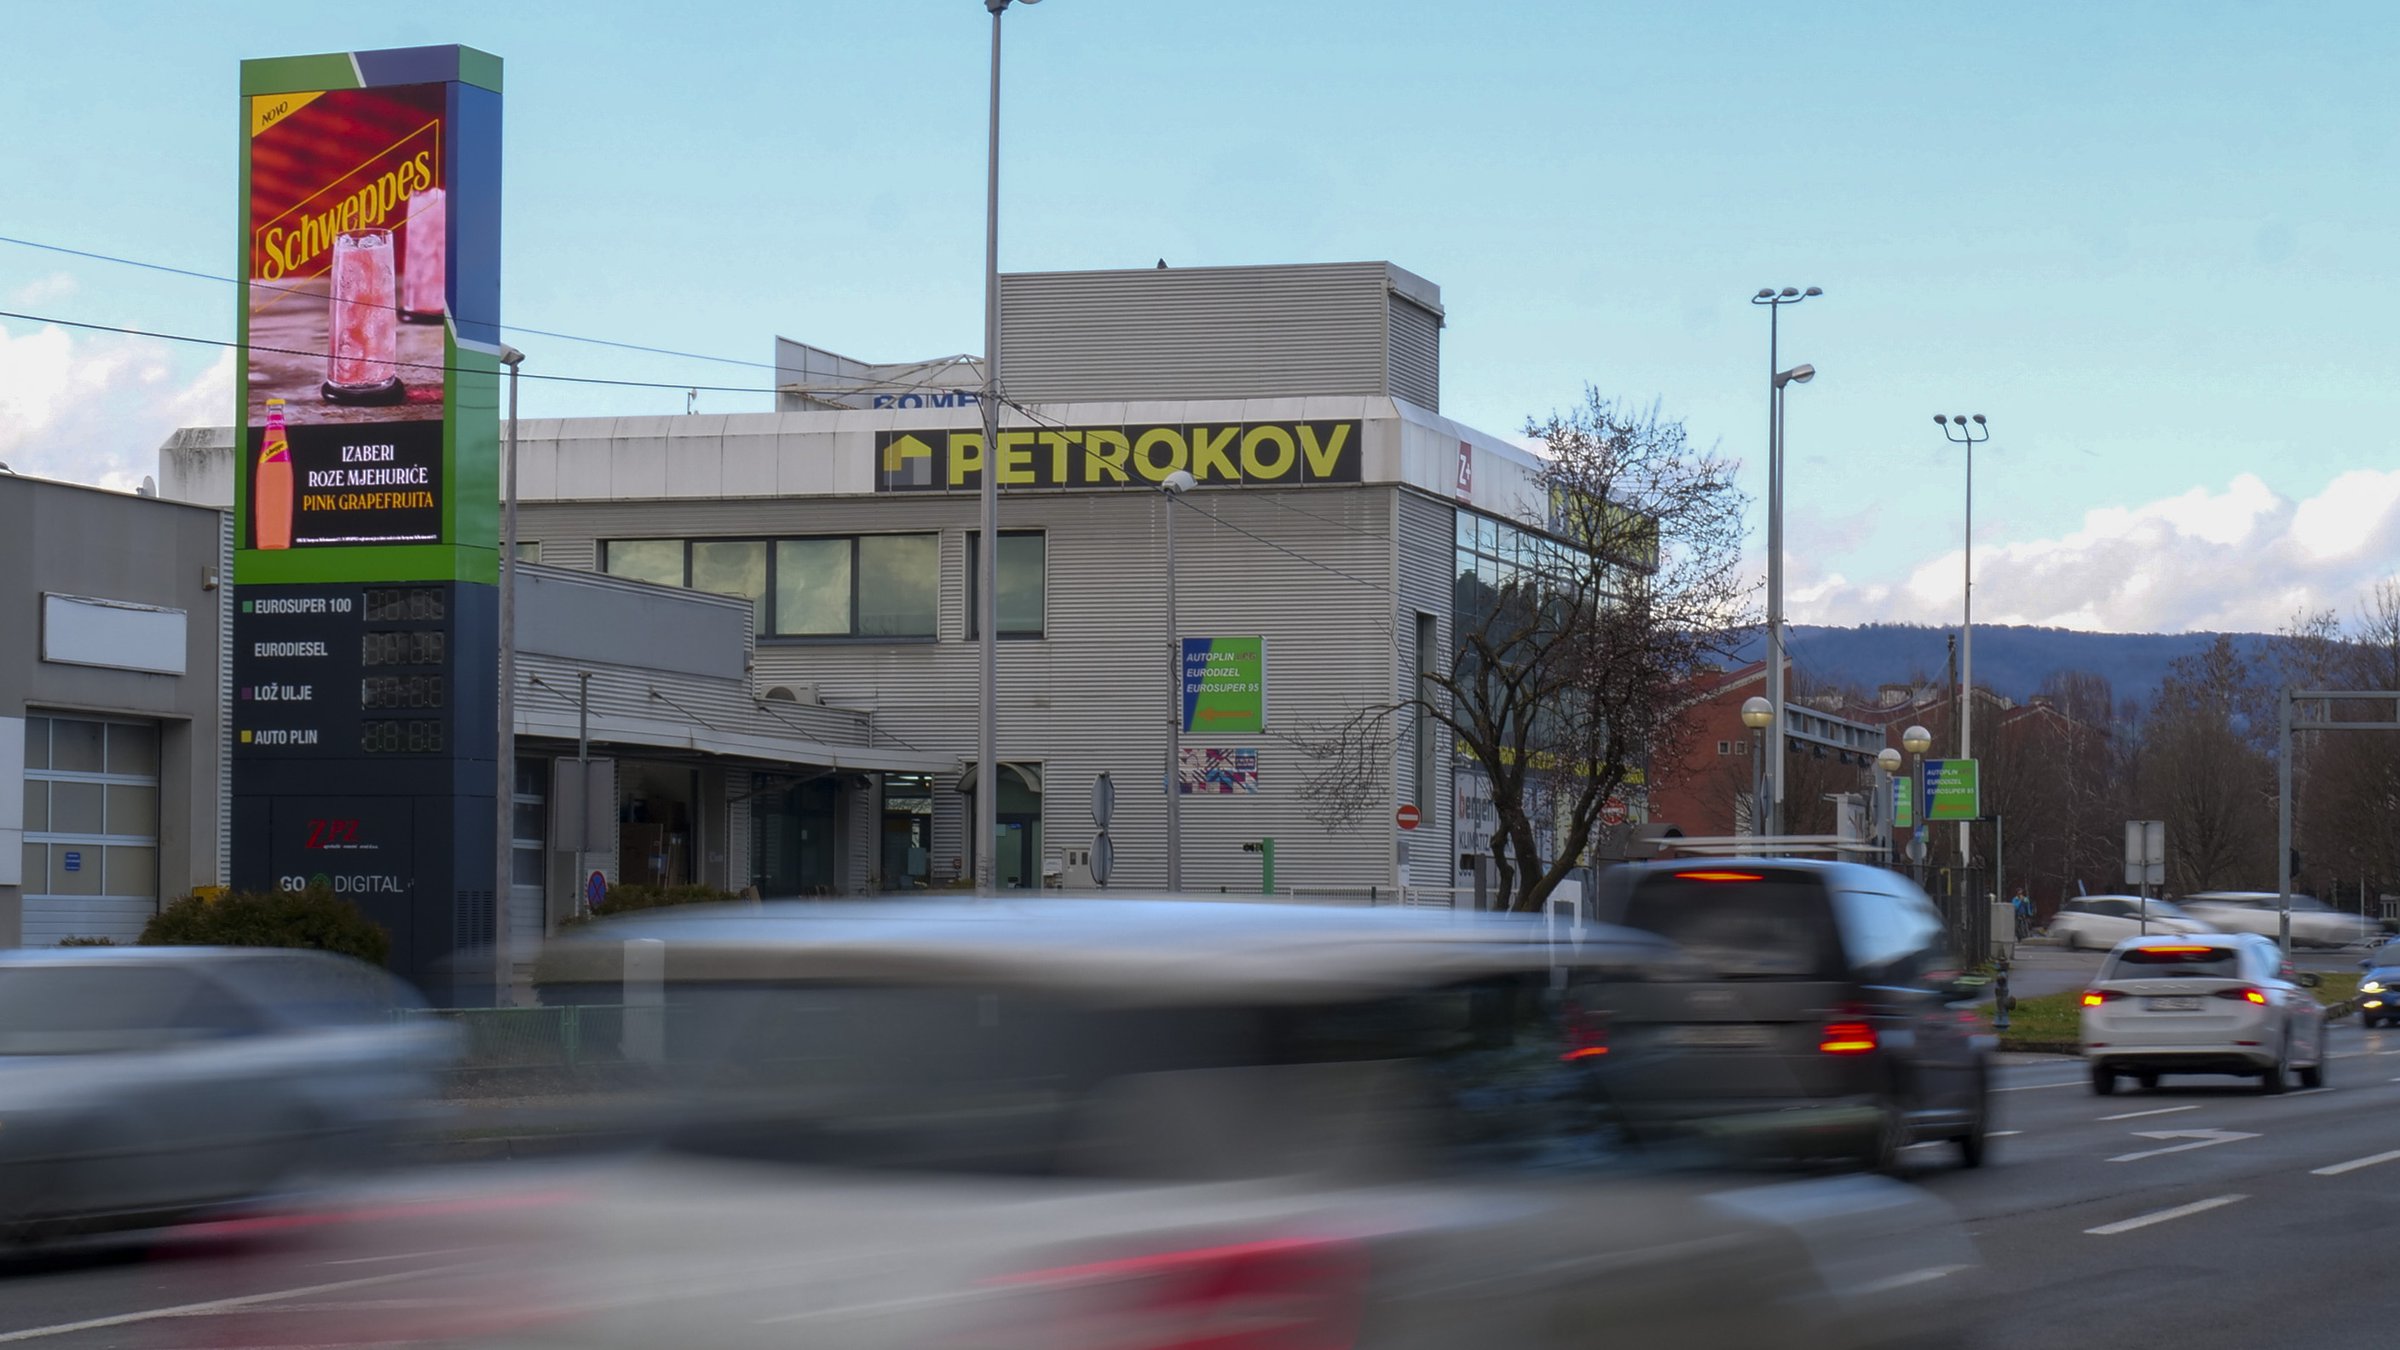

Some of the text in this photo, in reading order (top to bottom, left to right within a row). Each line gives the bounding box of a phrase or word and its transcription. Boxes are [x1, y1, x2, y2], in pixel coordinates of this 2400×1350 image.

[262, 101, 288, 126] NOVO
[262, 150, 431, 282] Schweppes
[342, 445, 394, 463] IZABERI
[949, 425, 1351, 485] PETROKOV
[308, 470, 345, 487] ROZE
[303, 491, 434, 511] PINK GRAPEFRUITA
[255, 598, 351, 614] EUROSUPER 100
[254, 642, 328, 657] EURODIESEL
[1186, 652, 1235, 662] AUTOPLIN
[1186, 668, 1240, 677] EURODIZEL
[254, 682, 312, 701] LOŽ ULJE
[1186, 683, 1260, 693] EUROSUPER 95
[255, 730, 318, 744] AUTO PLIN
[280, 875, 404, 893] GO DIGITAL
